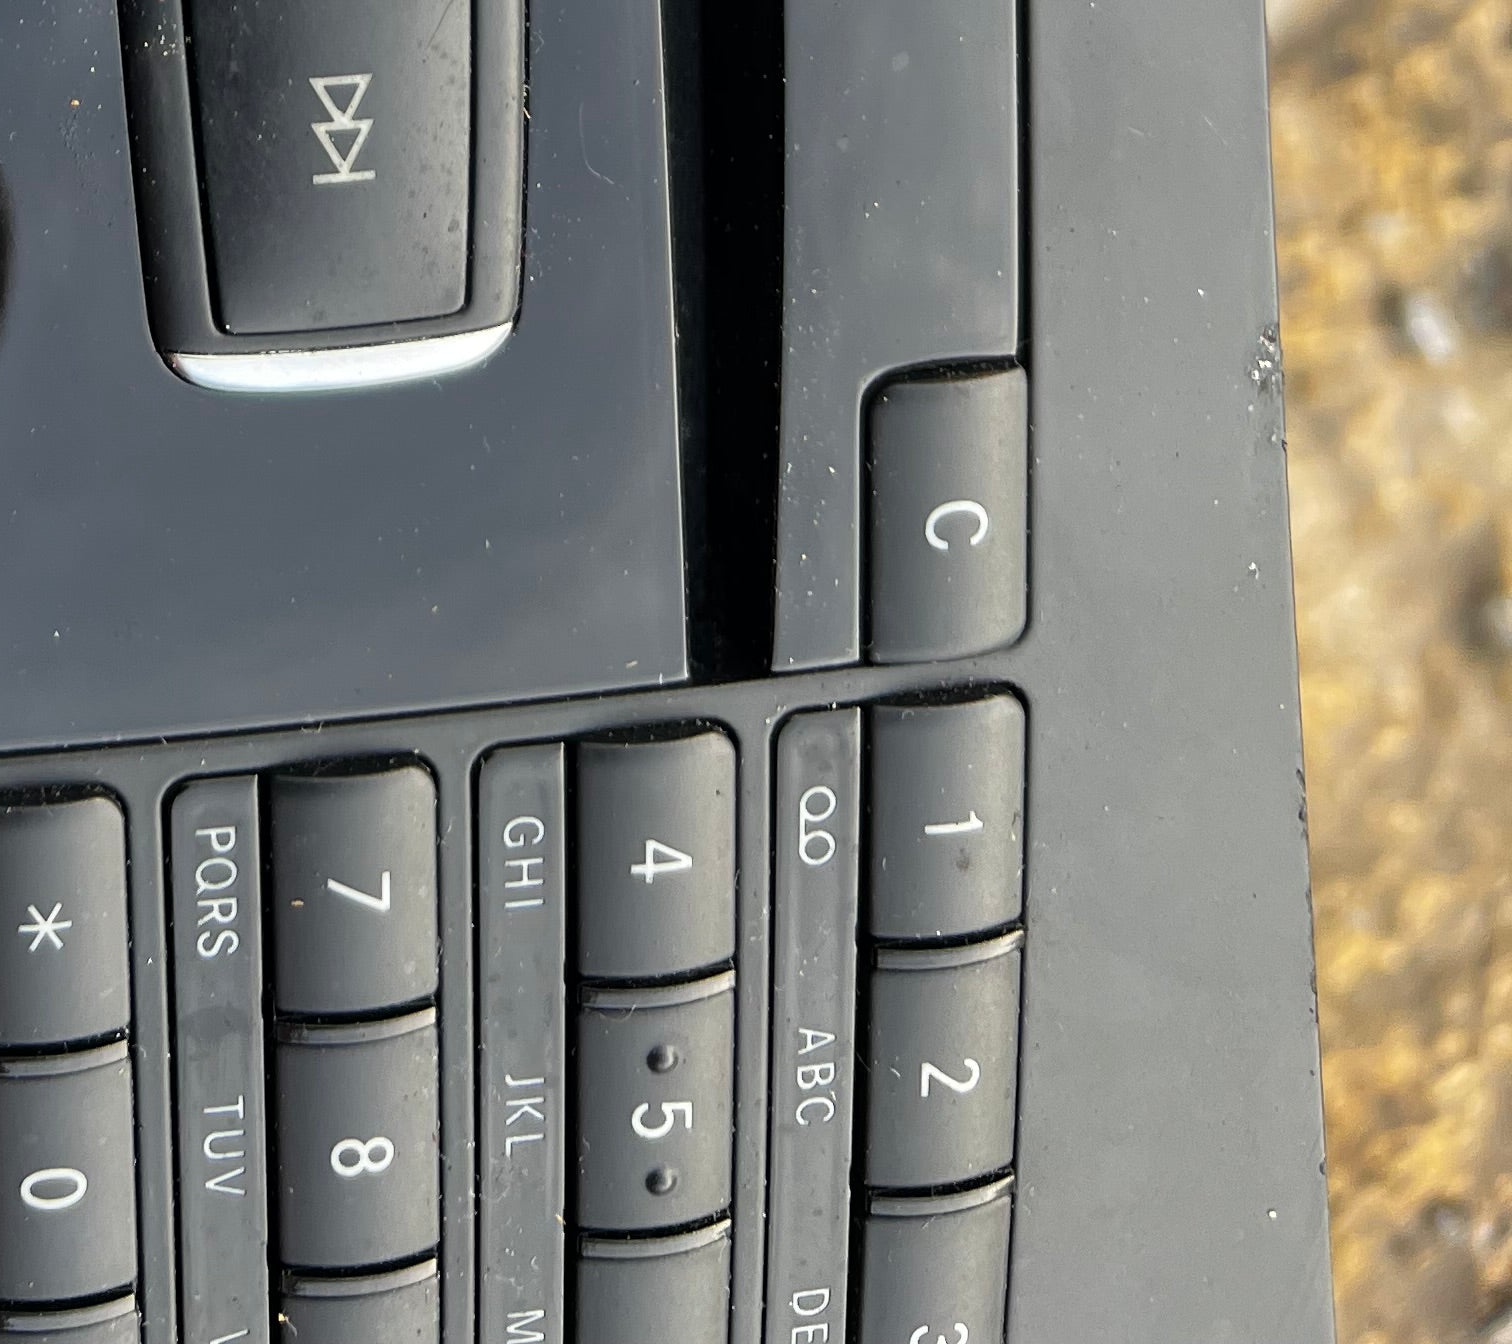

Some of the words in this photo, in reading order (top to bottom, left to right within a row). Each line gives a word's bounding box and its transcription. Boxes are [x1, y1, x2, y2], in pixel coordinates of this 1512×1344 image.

[925, 501, 988, 549] C
[925, 811, 983, 834] 1
[504, 817, 544, 907] GHI
[631, 840, 692, 883] 4
[196, 827, 238, 957] PQRS
[328, 872, 390, 911] 7
[796, 1028, 835, 1125] ABC
[921, 1059, 979, 1097] 2
[505, 1075, 544, 1157] JKL
[632, 1102, 692, 1139] 5
[204, 1095, 244, 1194] TUV
[331, 1138, 394, 1177] 8
[21, 1169, 86, 1209] 0
